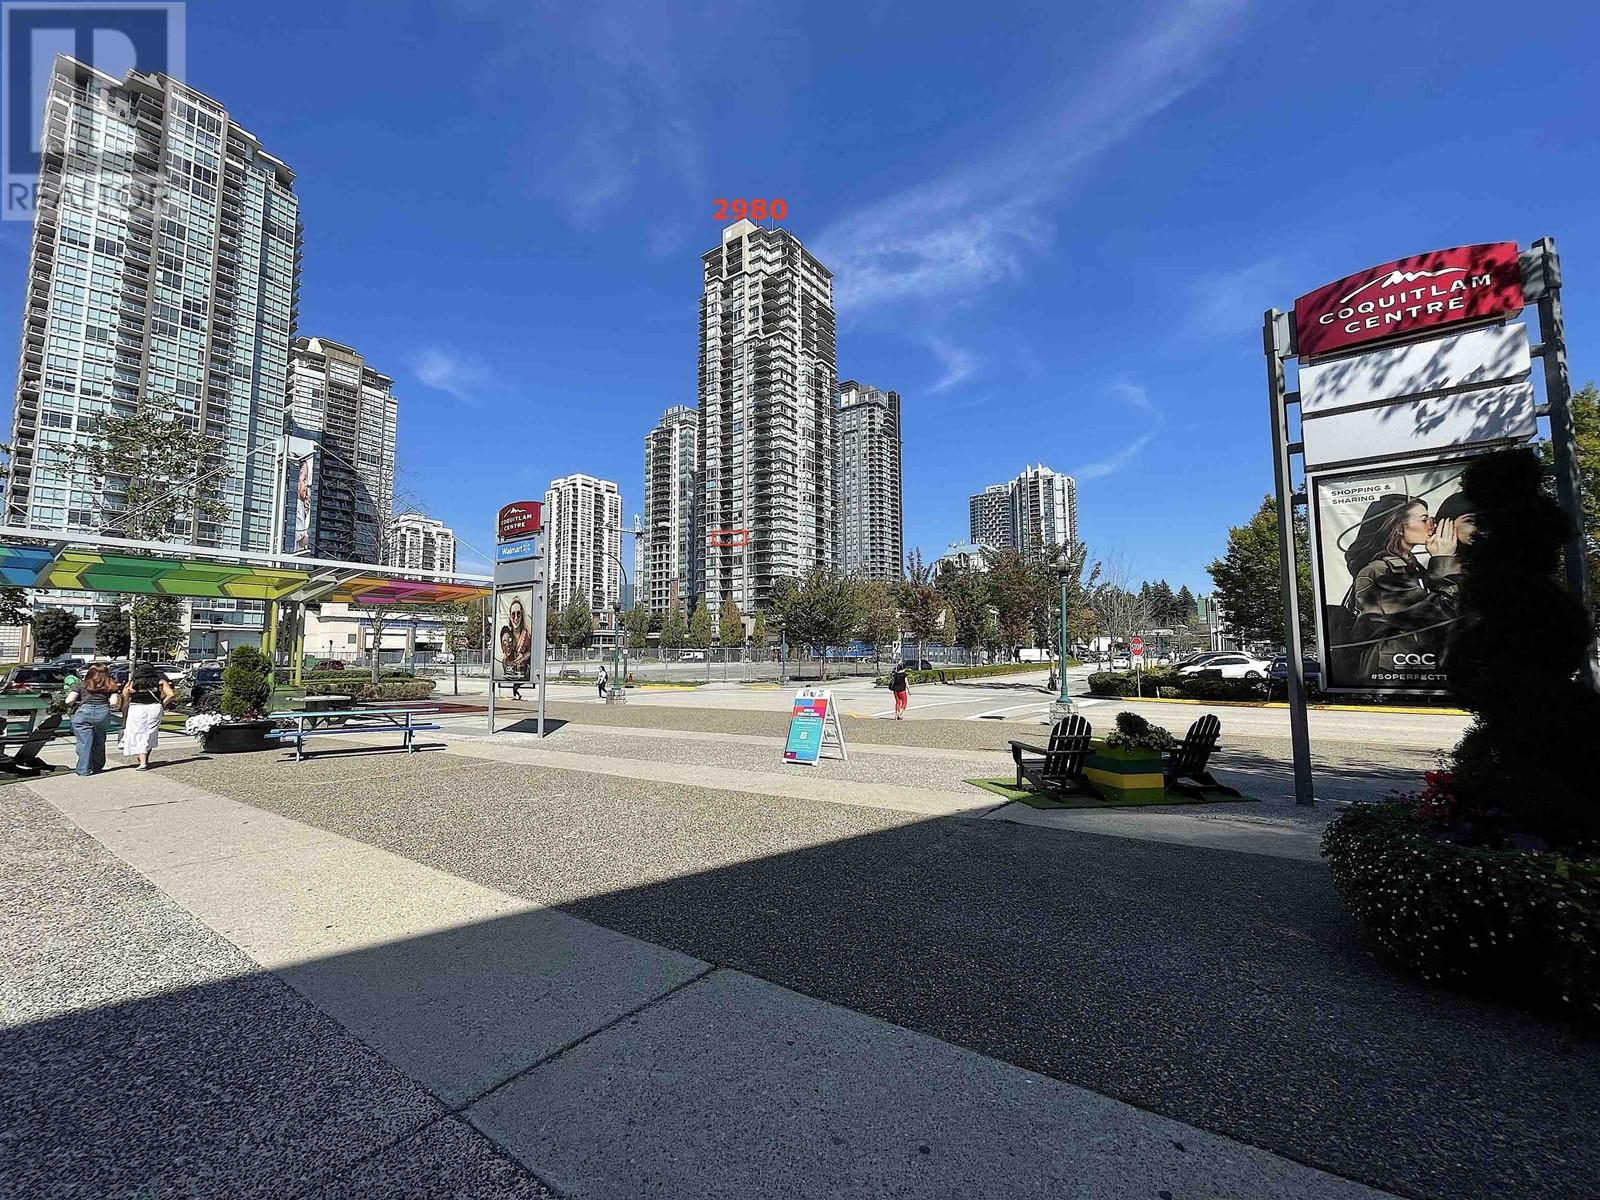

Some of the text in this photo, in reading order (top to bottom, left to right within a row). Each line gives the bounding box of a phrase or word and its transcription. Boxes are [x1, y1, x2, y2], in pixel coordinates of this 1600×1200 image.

[1319, 273, 1492, 325] COQUITLAM
[1344, 296, 1465, 334] CENTRE
[1331, 485, 1381, 497] SHOPPING
[1331, 495, 1375, 505] SHARING
[501, 513, 532, 526] COQUITLAM
[503, 521, 526, 532] CENTRE
[502, 545, 523, 555] Walmart
[1393, 653, 1436, 665] CQC
